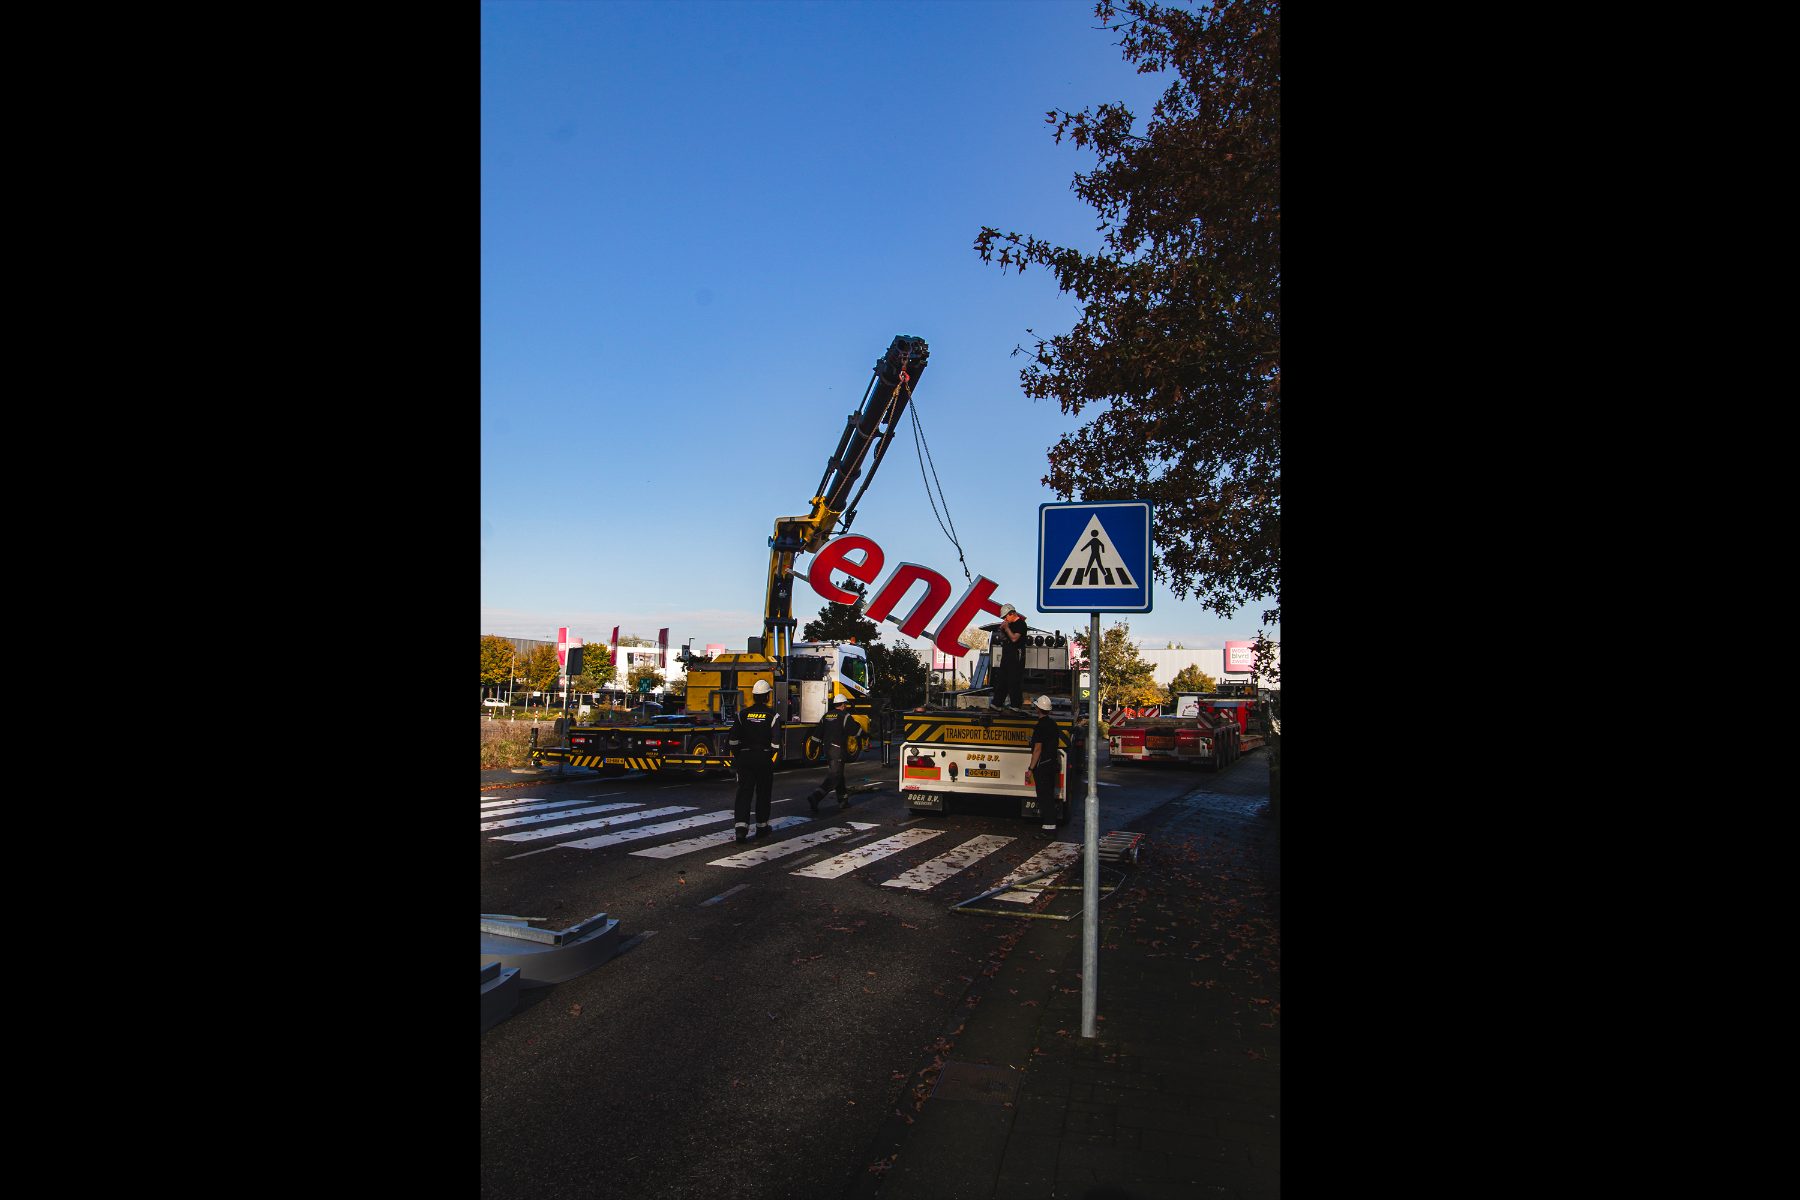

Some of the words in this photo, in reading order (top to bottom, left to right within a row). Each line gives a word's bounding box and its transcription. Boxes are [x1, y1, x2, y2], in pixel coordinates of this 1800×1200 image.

[808, 533, 1026, 657] ent
[946, 728, 981, 739] TRANSPORT
[983, 730, 1027, 741] EXCEPTIONNEL
[966, 753, 986, 761] BOER
[987, 754, 1000, 762] B.V.
[907, 793, 926, 801] BOER
